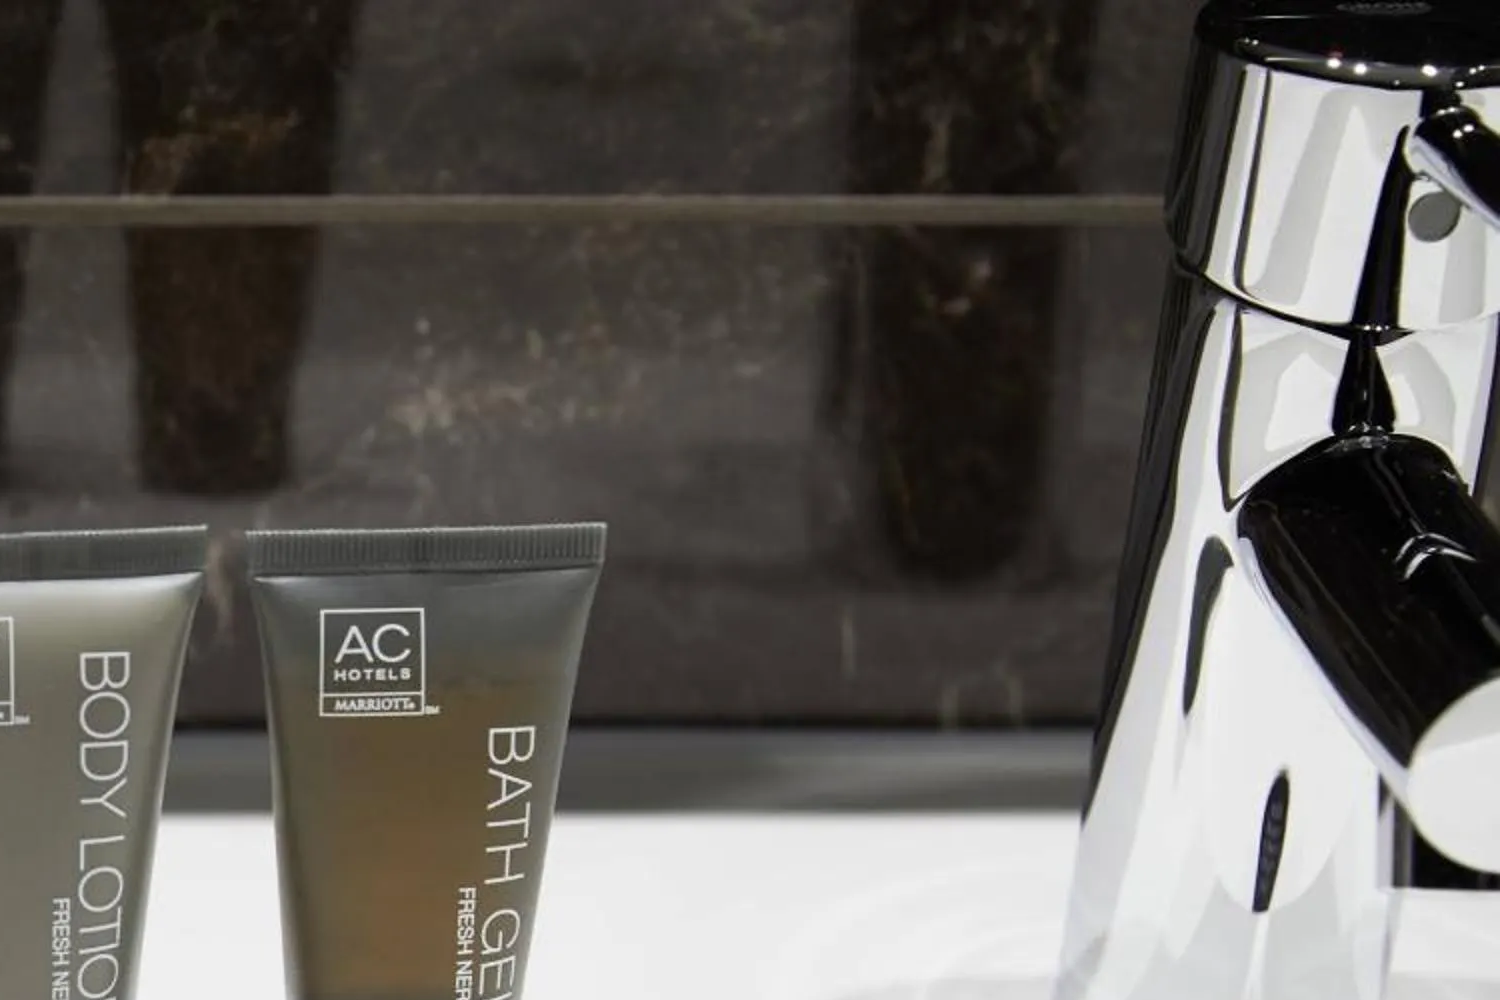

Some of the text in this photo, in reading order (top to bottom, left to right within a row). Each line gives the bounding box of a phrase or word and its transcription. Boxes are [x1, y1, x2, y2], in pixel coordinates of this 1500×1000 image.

[333, 667, 411, 681] HOTELS
[334, 623, 411, 663] AC
[79, 651, 131, 819] BODY
[484, 725, 536, 885] BATH
[52, 898, 70, 965] FRESH
[456, 887, 476, 955] FRESH
